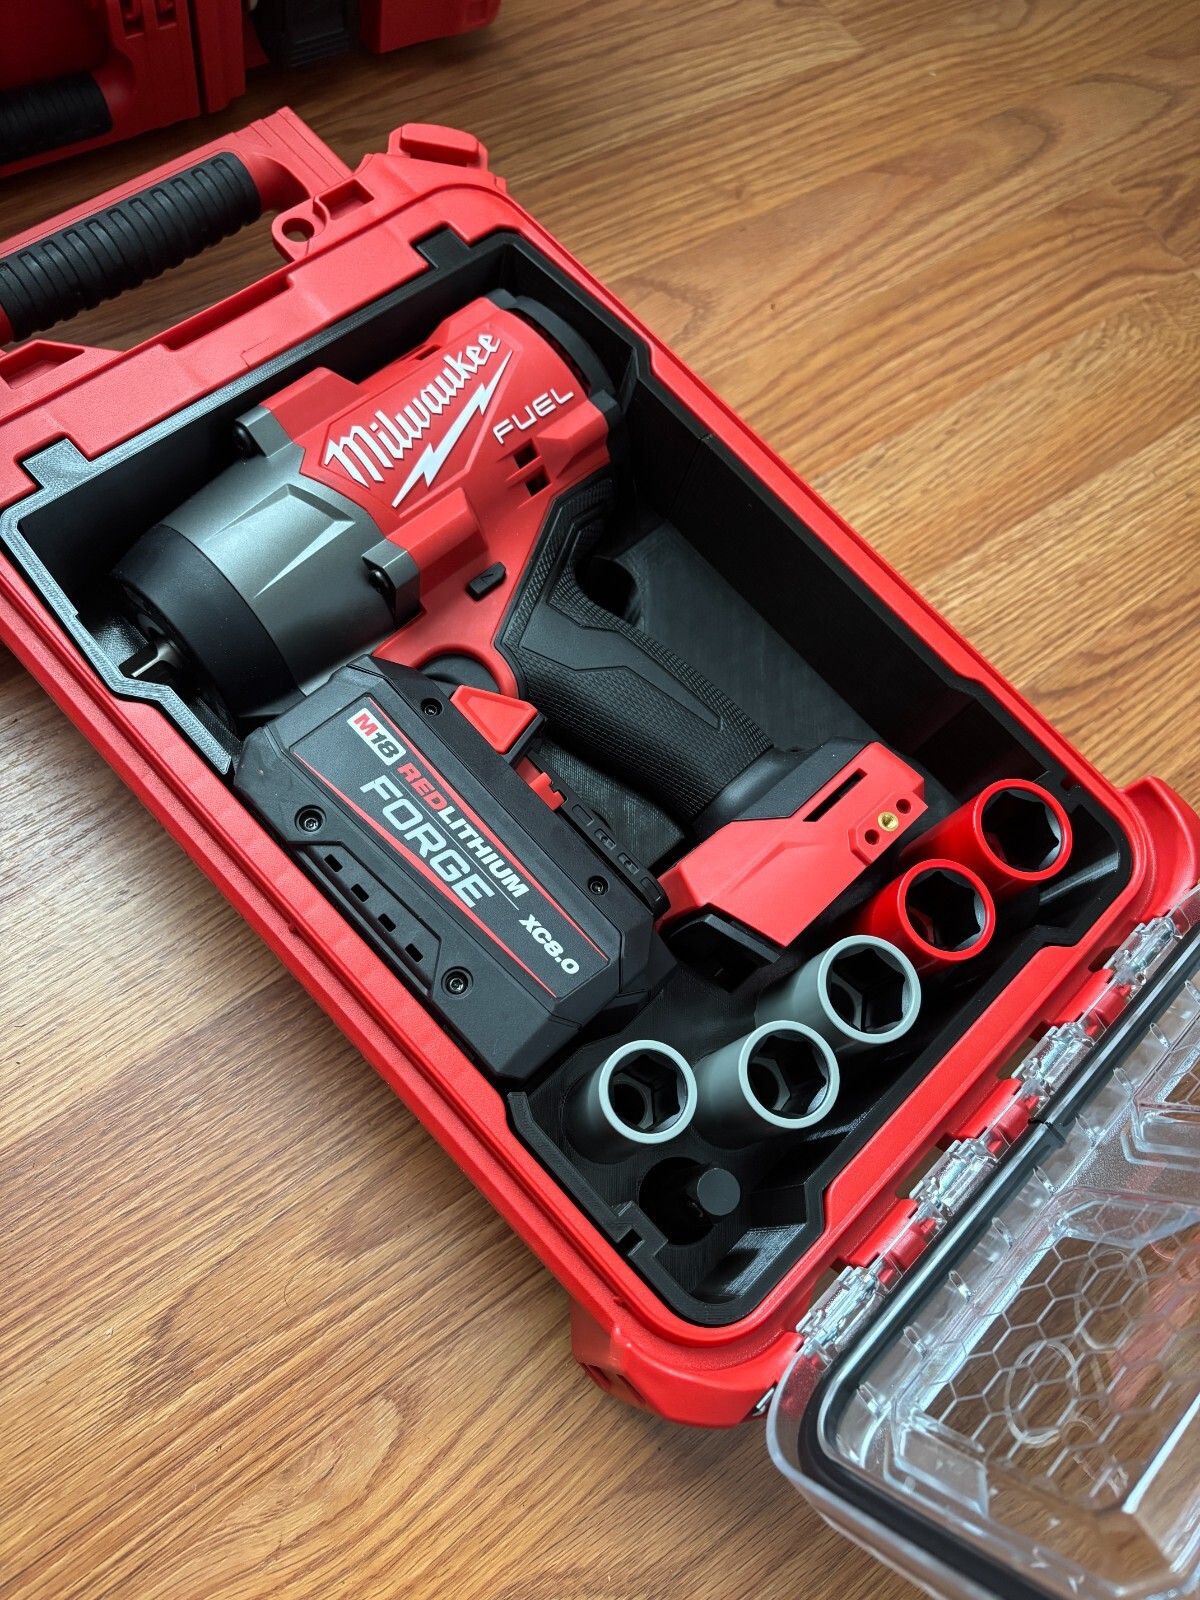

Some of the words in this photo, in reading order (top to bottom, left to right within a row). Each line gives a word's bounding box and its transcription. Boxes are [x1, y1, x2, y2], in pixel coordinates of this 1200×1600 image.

[324, 334, 500, 488] Milwaukee
[493, 389, 574, 445] FUEL
[353, 714, 399, 759] M18
[397, 762, 529, 898] REDLITHIUM
[360, 774, 495, 908] FORGE
[518, 914, 580, 975] XC8.0
